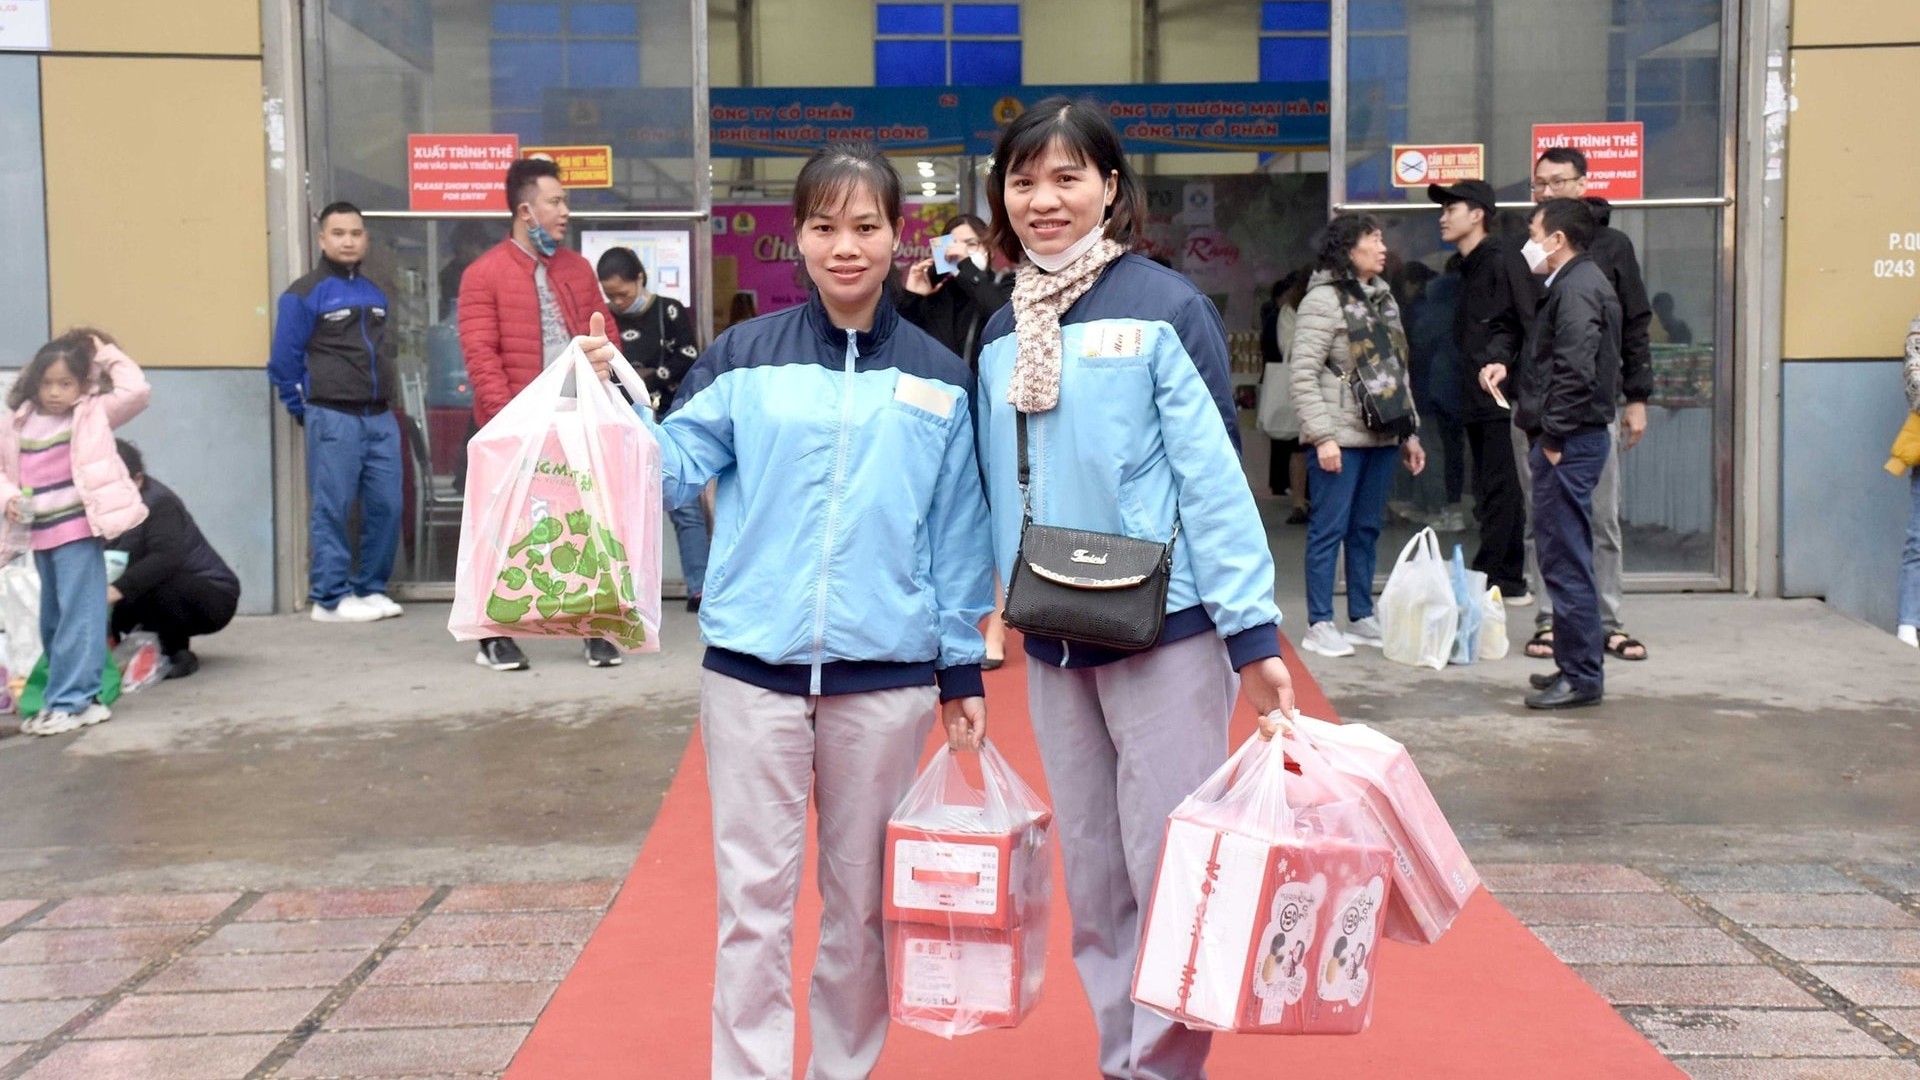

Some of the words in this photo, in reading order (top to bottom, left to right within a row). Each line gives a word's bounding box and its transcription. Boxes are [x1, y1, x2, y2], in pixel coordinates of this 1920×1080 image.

[752, 107, 773, 120] TY
[1151, 103, 1172, 116] TY
[1250, 102, 1281, 118] MẠI
[1286, 98, 1310, 115] HÀ
[719, 126, 770, 141] PHÍCH
[878, 124, 928, 141] ĐÔNG
[1125, 121, 1173, 138] CÔNG
[1178, 124, 1198, 137] TY
[1537, 133, 1571, 148] XUẤT
[1572, 133, 1611, 147] TRÌNH
[1612, 131, 1638, 146] THẺ
[413, 143, 449, 159] XUẤT
[450, 144, 491, 159] TRÌNH
[492, 141, 514, 159] THẺ
[1618, 149, 1639, 158] LÂM
[413, 161, 430, 170] KHI
[430, 160, 449, 170] VÀO
[449, 160, 468, 170] NHÀ
[1616, 170, 1637, 178] PASS
[413, 182, 443, 191] PLEASE
[443, 182, 470, 191] SHOW
[470, 182, 493, 191] YOUR
[442, 193, 460, 201] FOR
[460, 193, 488, 201] ENTRY
[1874, 259, 1915, 278] 0243
